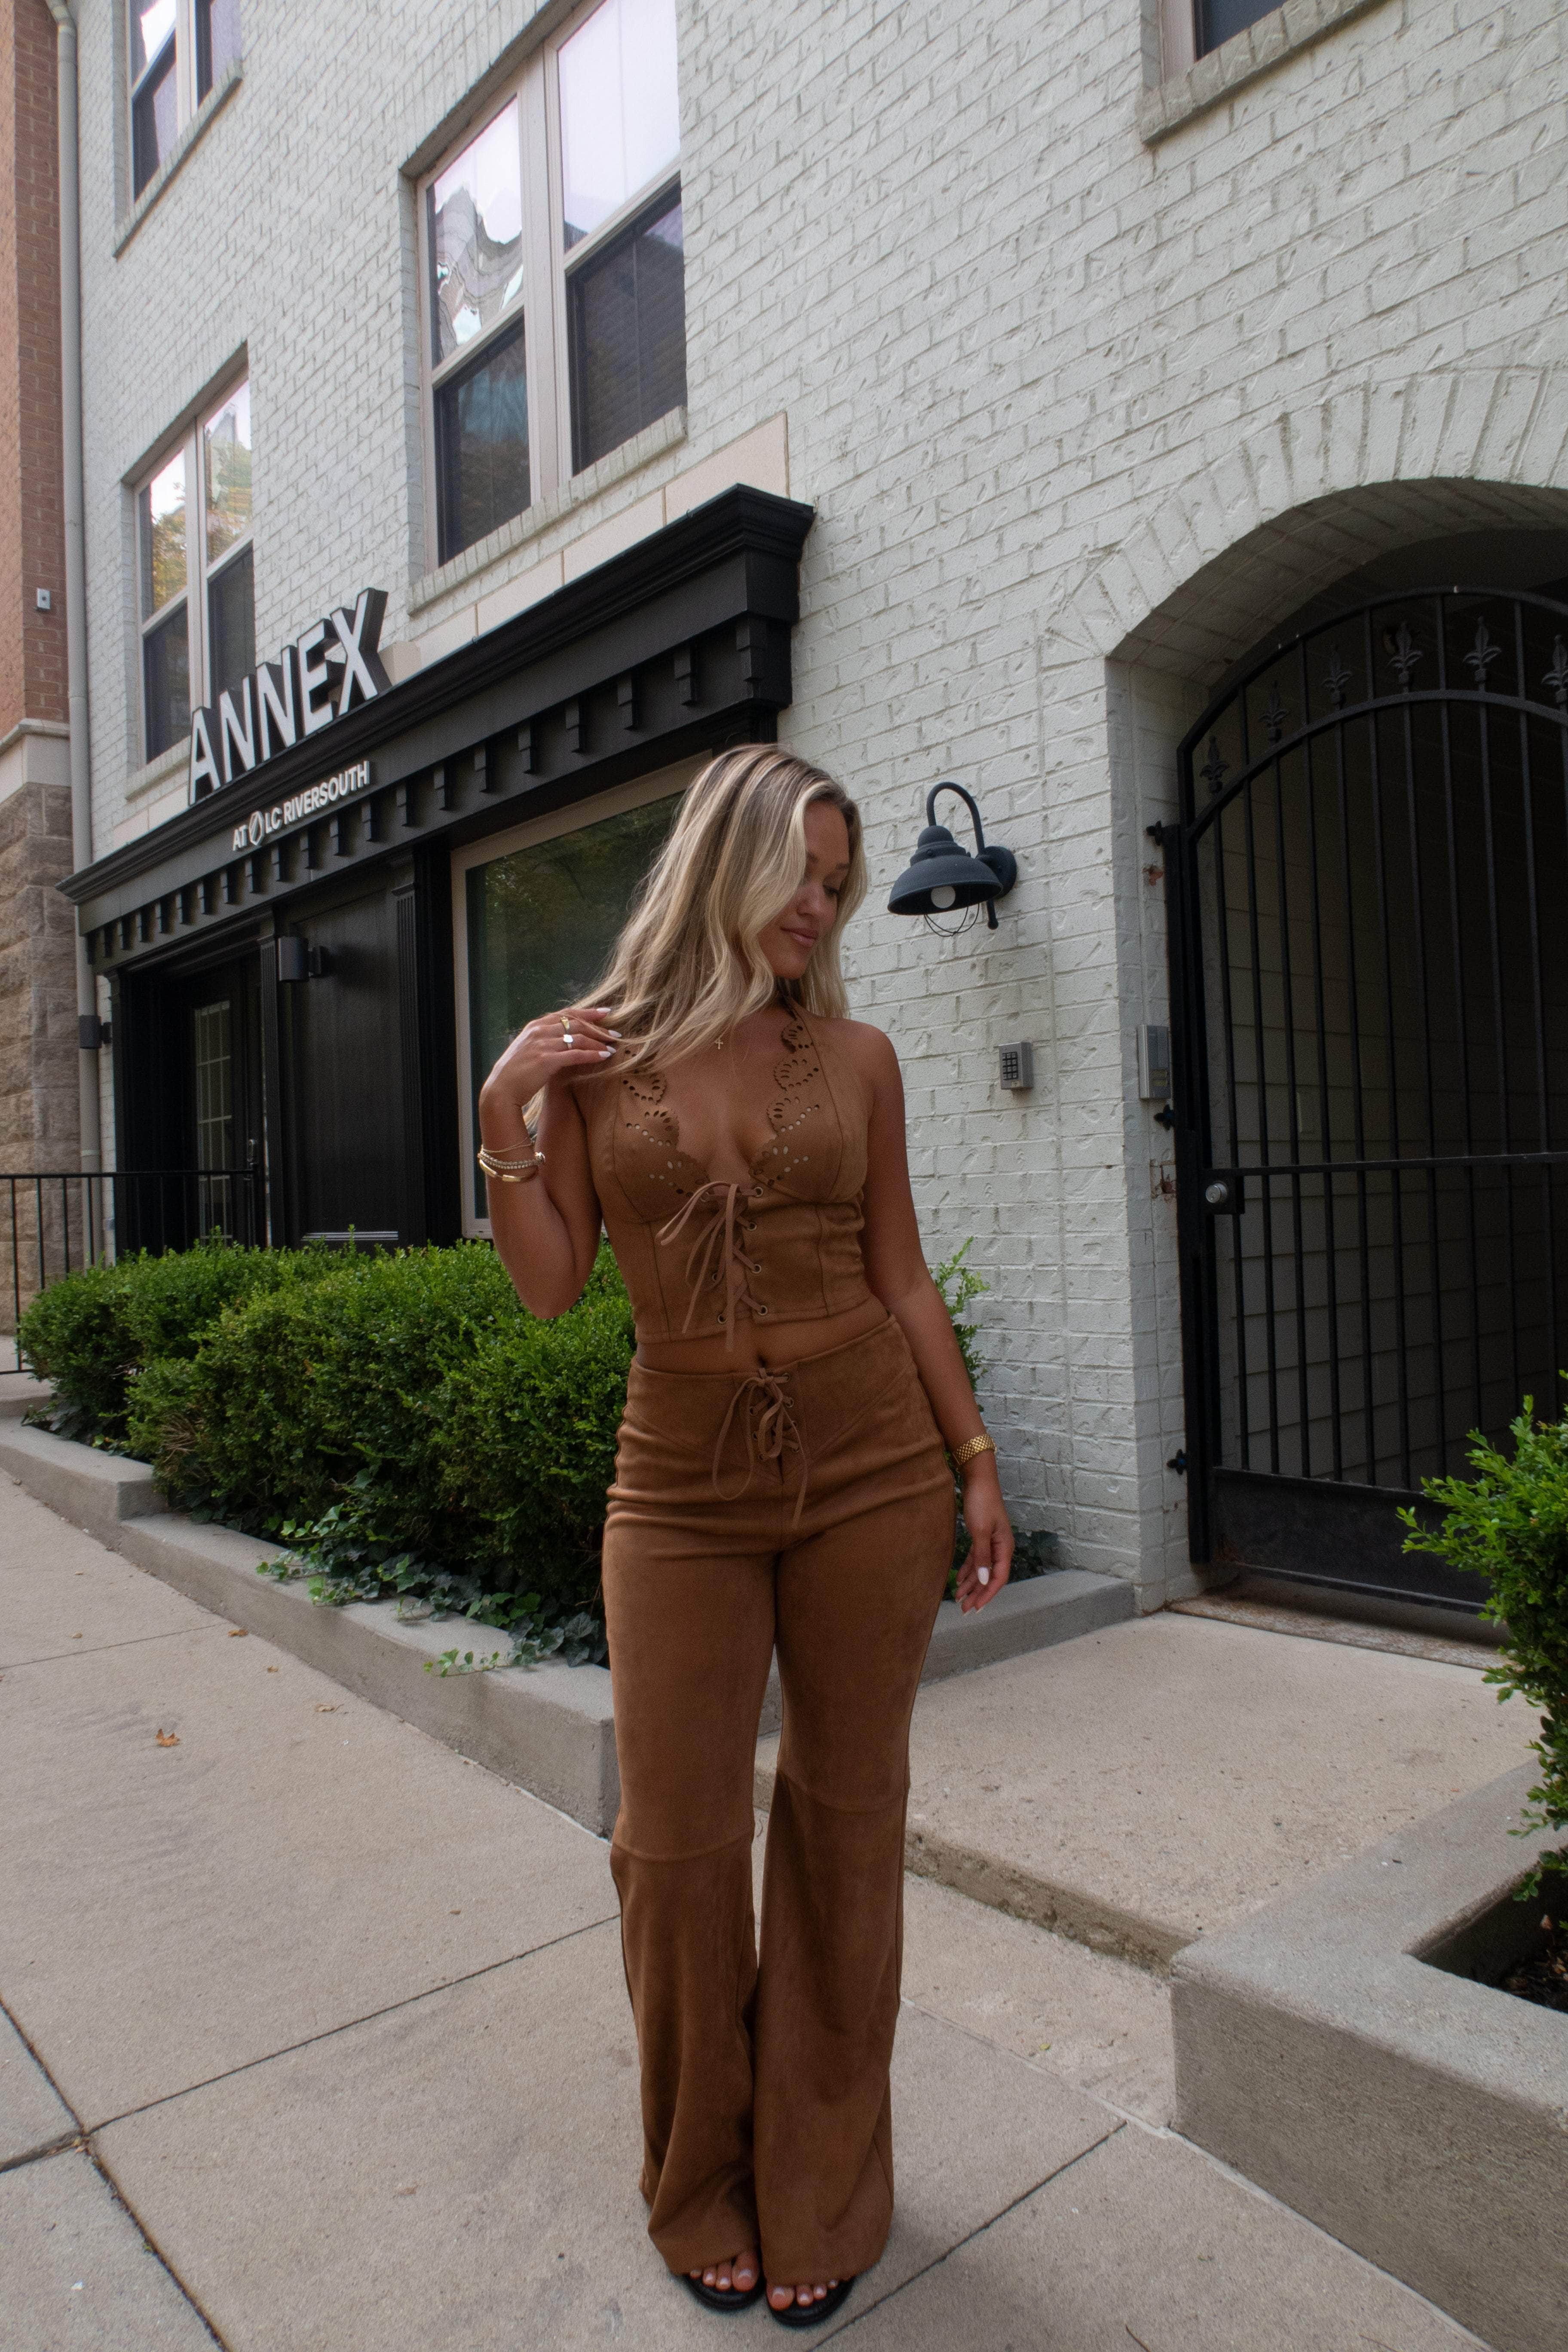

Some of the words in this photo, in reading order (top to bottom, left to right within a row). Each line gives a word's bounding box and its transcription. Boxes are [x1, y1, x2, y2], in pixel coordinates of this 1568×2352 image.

[189, 588, 383, 805] ANNEX
[233, 824, 248, 851] AT
[264, 807, 282, 834] LC
[283, 760, 370, 825] RIVERSOUTH
